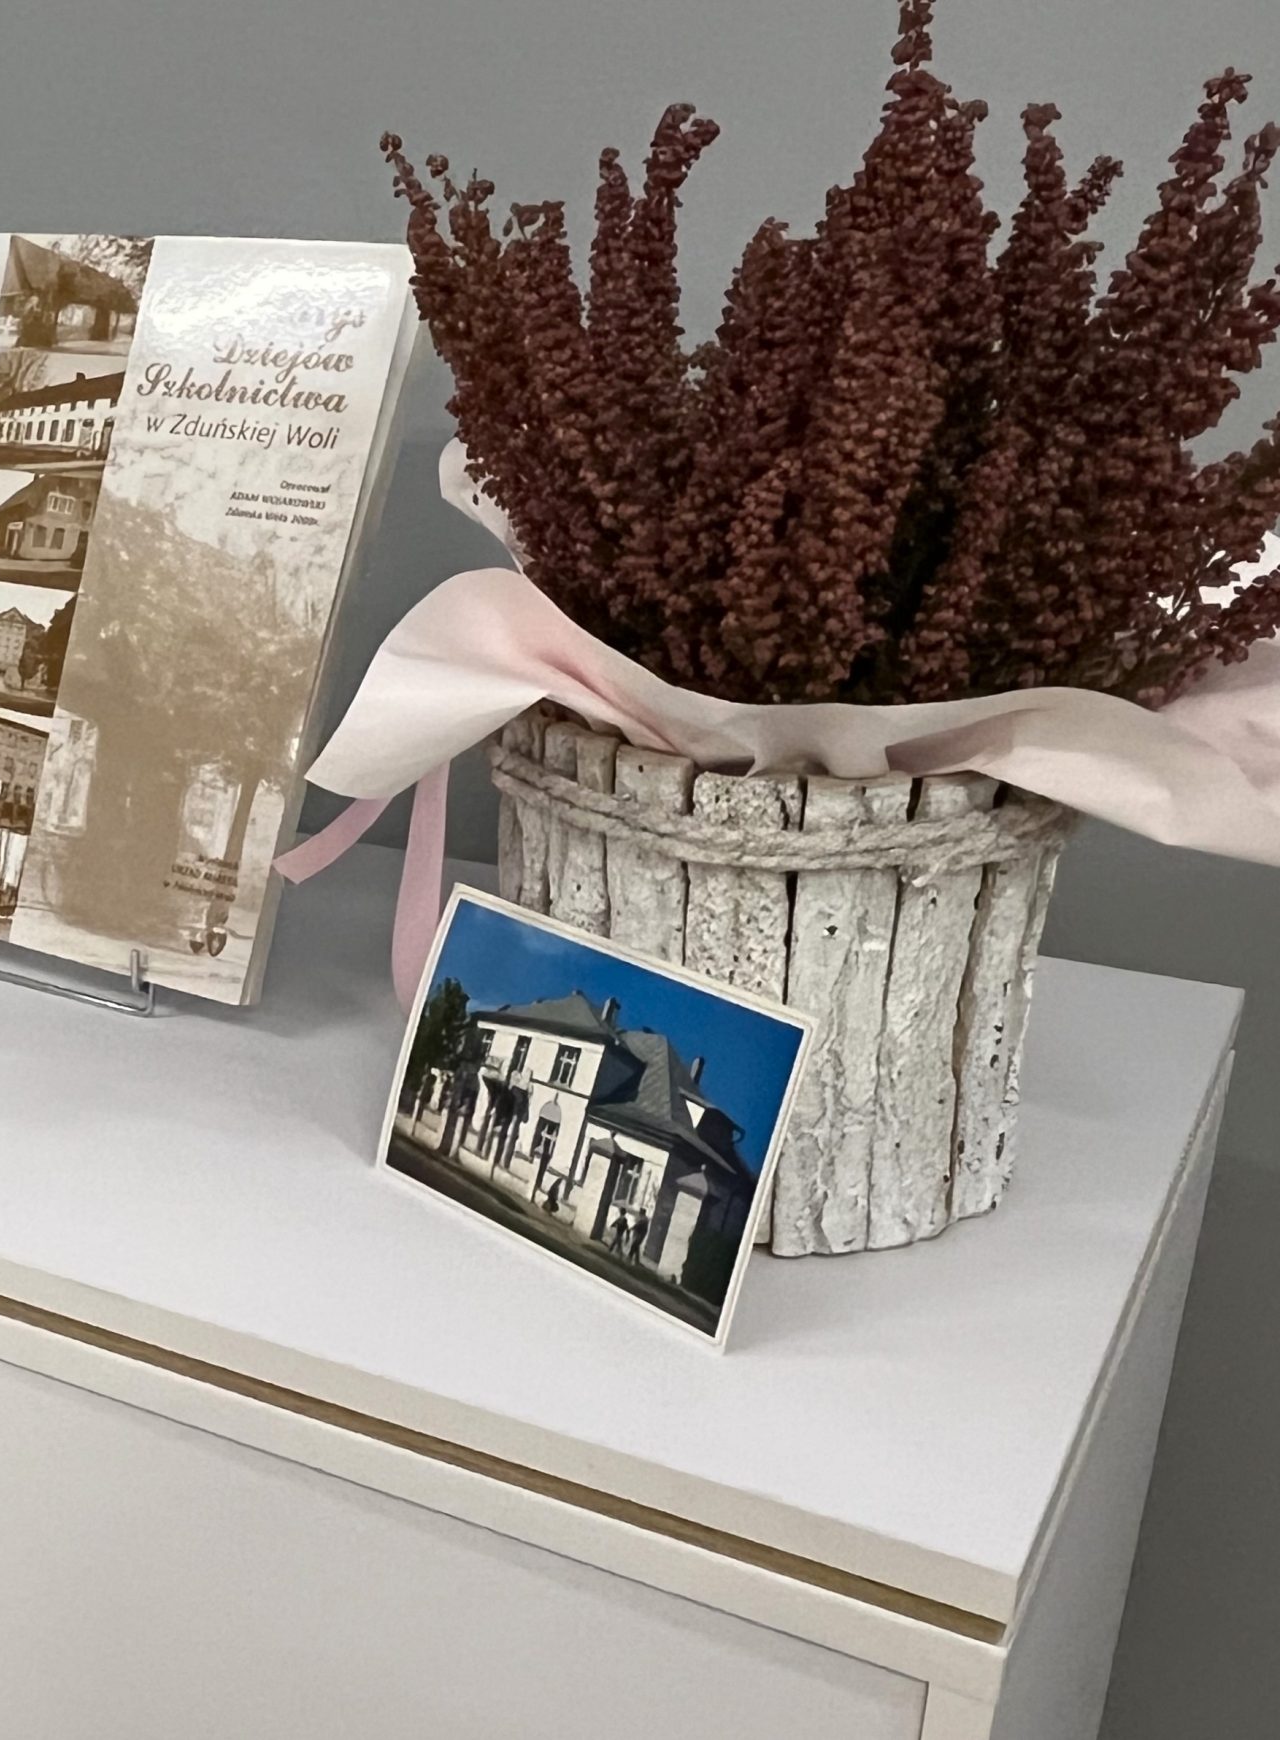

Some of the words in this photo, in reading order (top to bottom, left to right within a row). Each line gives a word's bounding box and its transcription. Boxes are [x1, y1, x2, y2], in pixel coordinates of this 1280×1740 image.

[212, 334, 355, 383] Dziejów
[136, 362, 349, 414] Szkolnictwa
[146, 416, 166, 433] w
[168, 413, 280, 450] Zduńskiej
[286, 424, 341, 450] Woli
